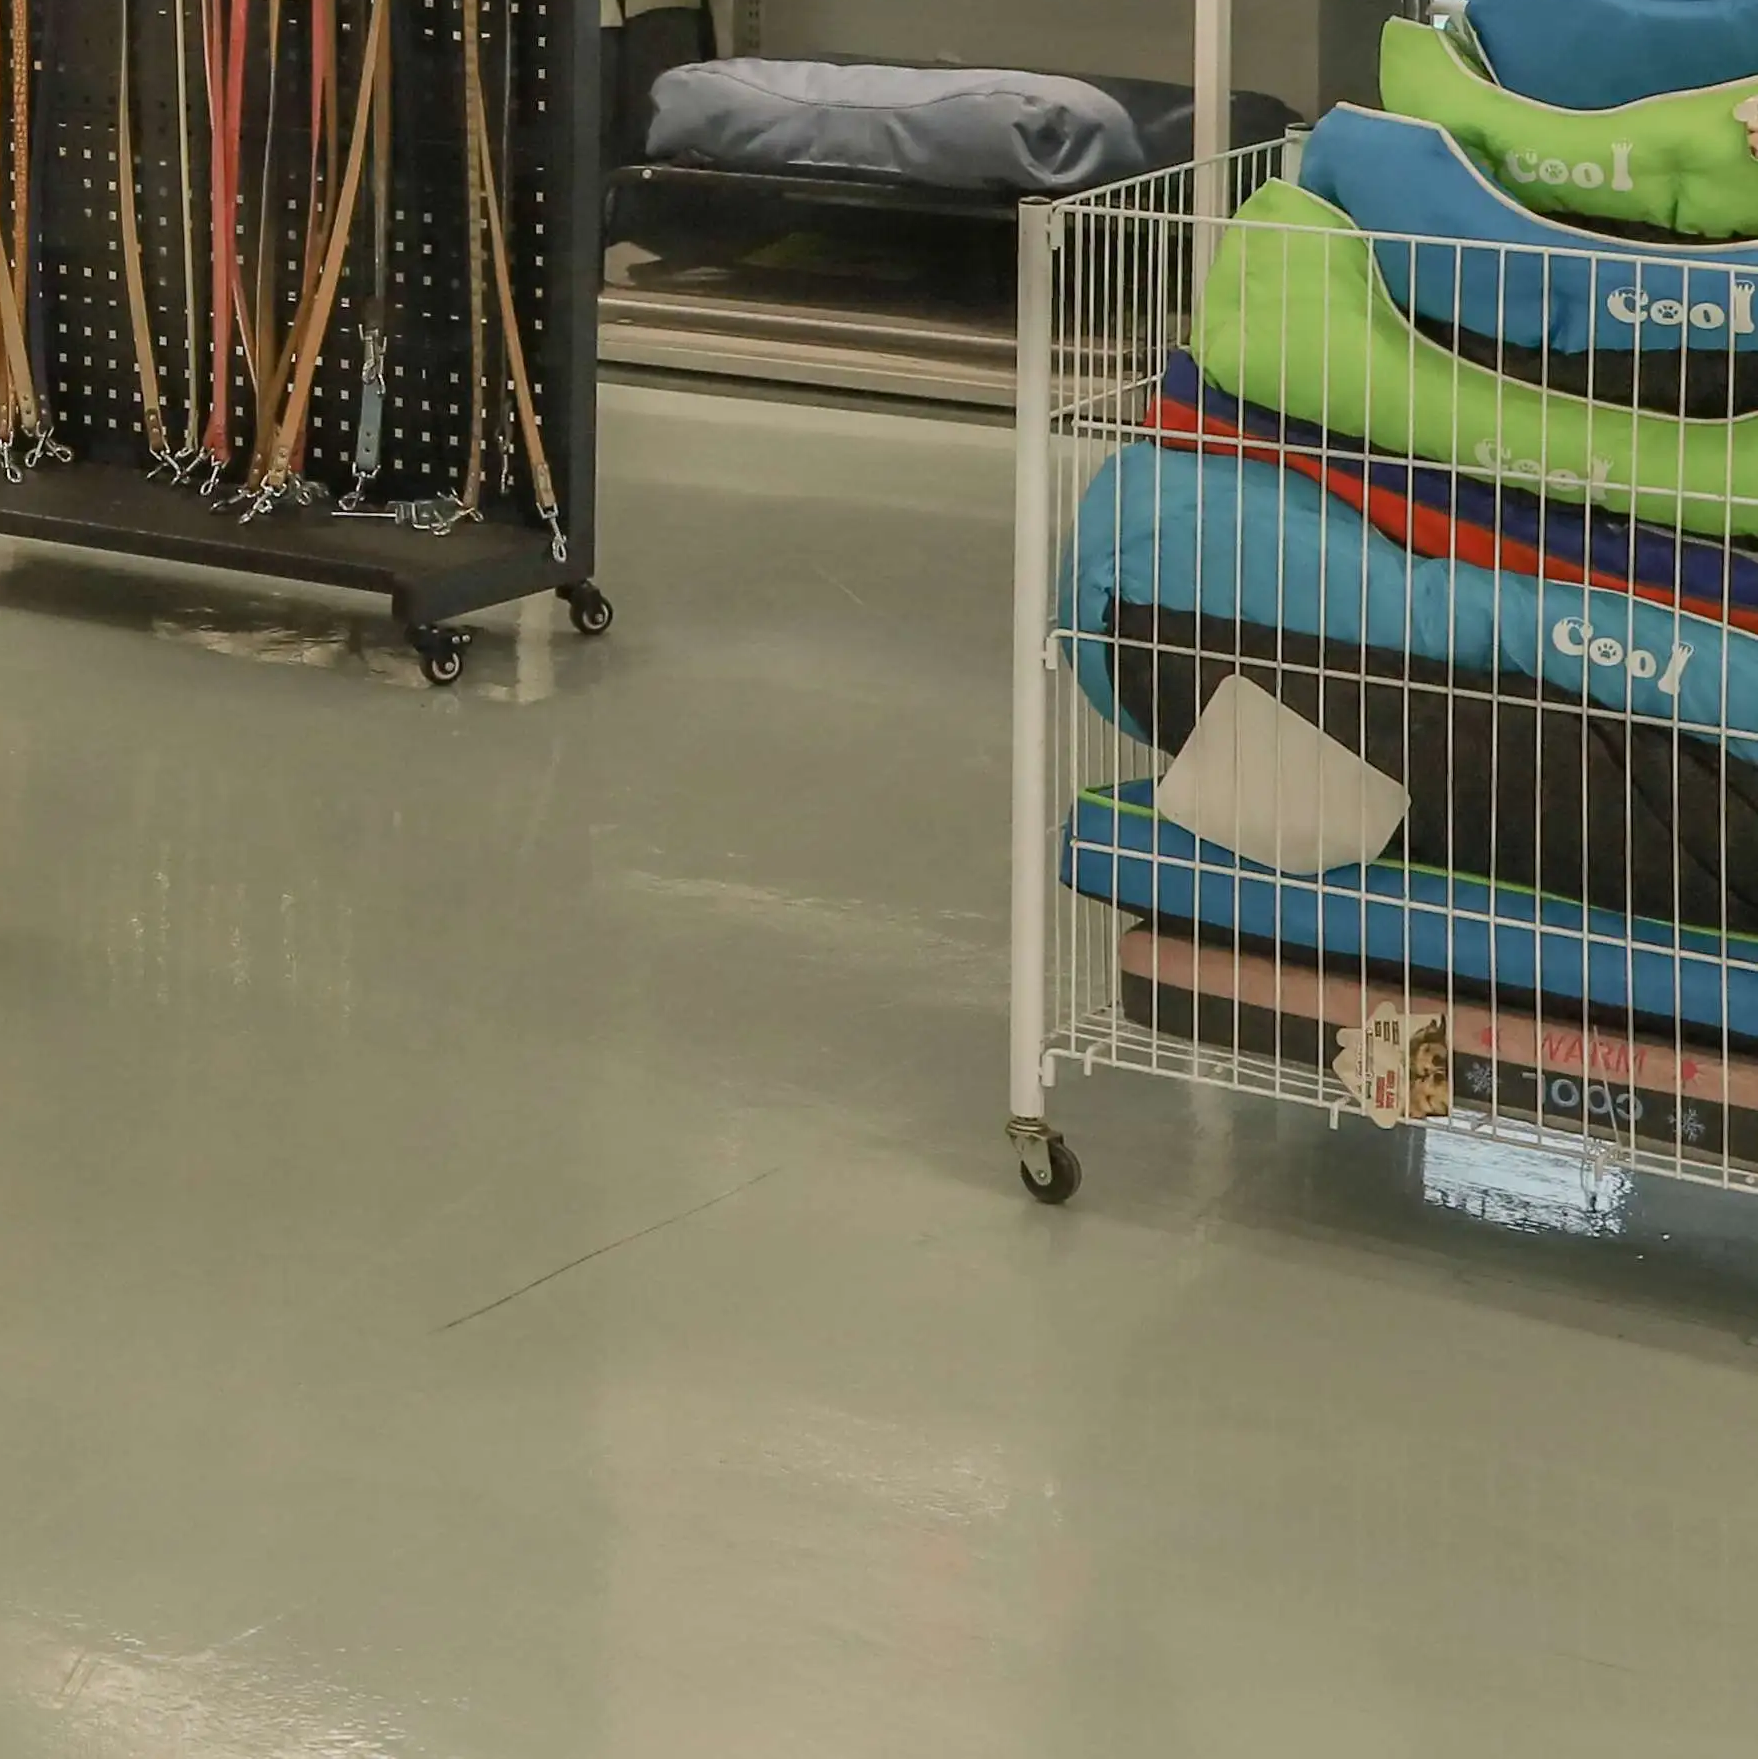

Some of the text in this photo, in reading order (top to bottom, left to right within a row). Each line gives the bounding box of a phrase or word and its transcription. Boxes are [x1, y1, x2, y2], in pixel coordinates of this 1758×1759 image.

[1505, 138, 1633, 192] Cool
[1605, 278, 1758, 336] Cool
[1551, 616, 1697, 696] Cool
